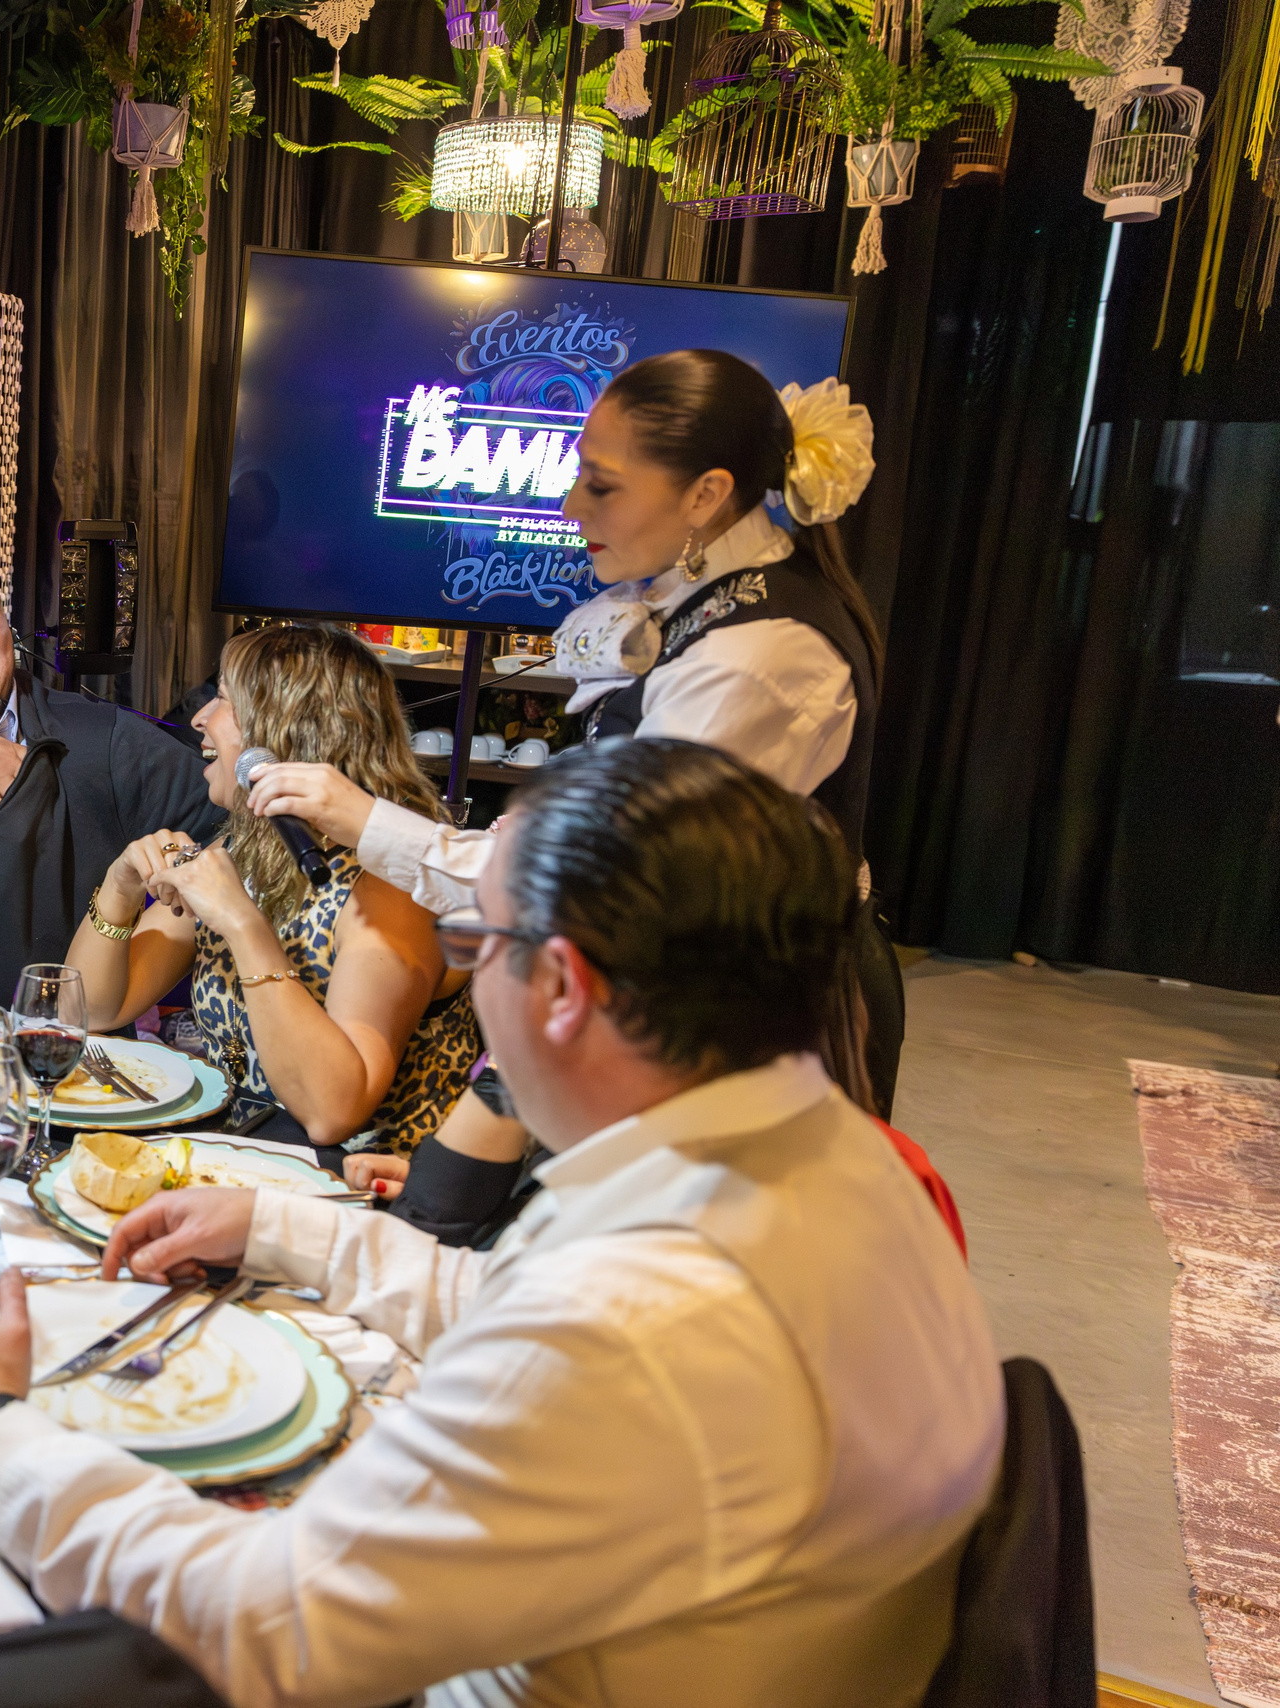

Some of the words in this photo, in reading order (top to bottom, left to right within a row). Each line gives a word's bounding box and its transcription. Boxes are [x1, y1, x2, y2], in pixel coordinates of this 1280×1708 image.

[462, 309, 626, 370] Eventos
[405, 385, 461, 427] MC
[399, 422, 580, 497] DAMI
[497, 530, 517, 541] BY
[519, 532, 562, 545] BLACK
[564, 535, 588, 547] LIO
